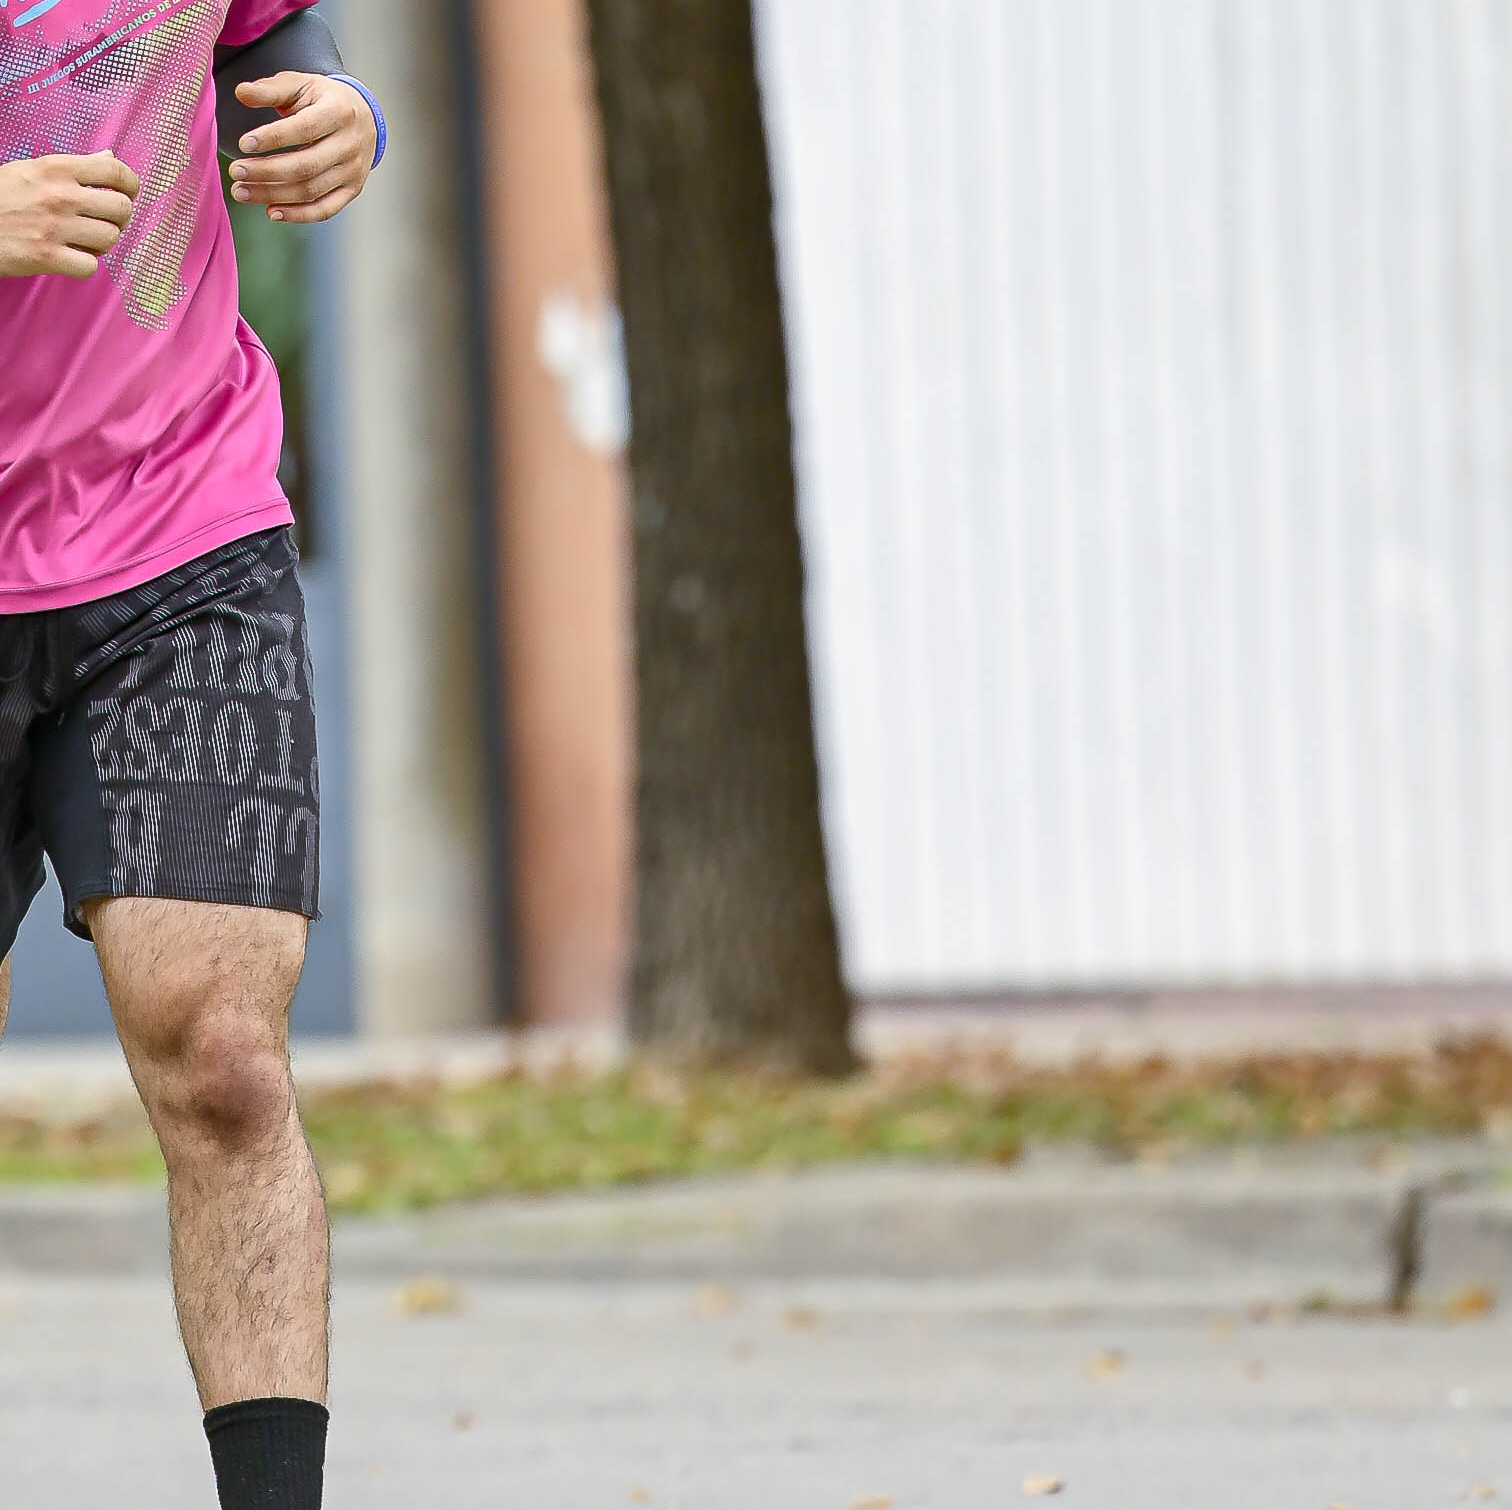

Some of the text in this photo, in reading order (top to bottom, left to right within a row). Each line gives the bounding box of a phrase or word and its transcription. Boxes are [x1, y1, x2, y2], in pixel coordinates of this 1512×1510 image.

[27, 83, 39, 95] III
[41, 64, 76, 89] JUEGOS
[75, 10, 158, 67] SURAMERICANOS
[157, 0, 172, 13] DE
